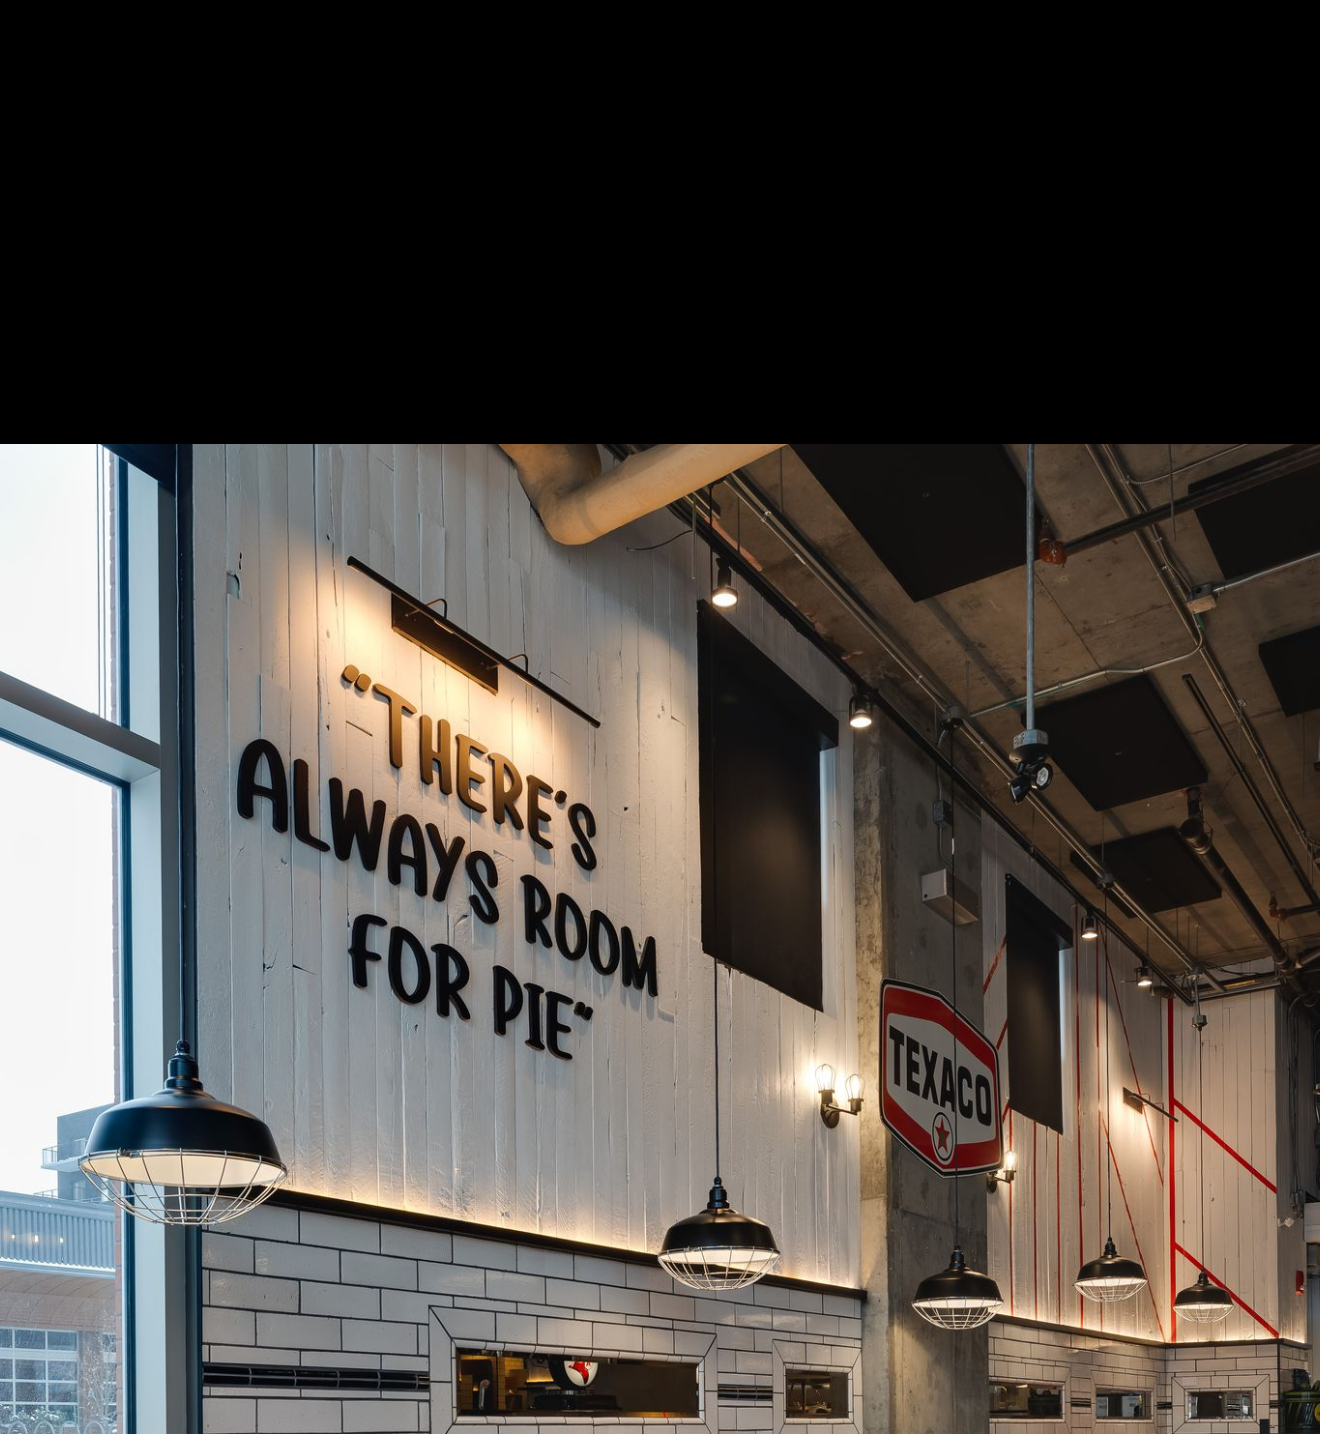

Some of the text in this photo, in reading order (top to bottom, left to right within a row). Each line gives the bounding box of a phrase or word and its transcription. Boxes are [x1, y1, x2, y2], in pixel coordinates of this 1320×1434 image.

[341, 664, 597, 871] "THERE'S
[236, 738, 659, 998] ALWAYS ROOM
[348, 913, 594, 1061] FOR PIE"
[889, 1024, 992, 1127] TEXACO
